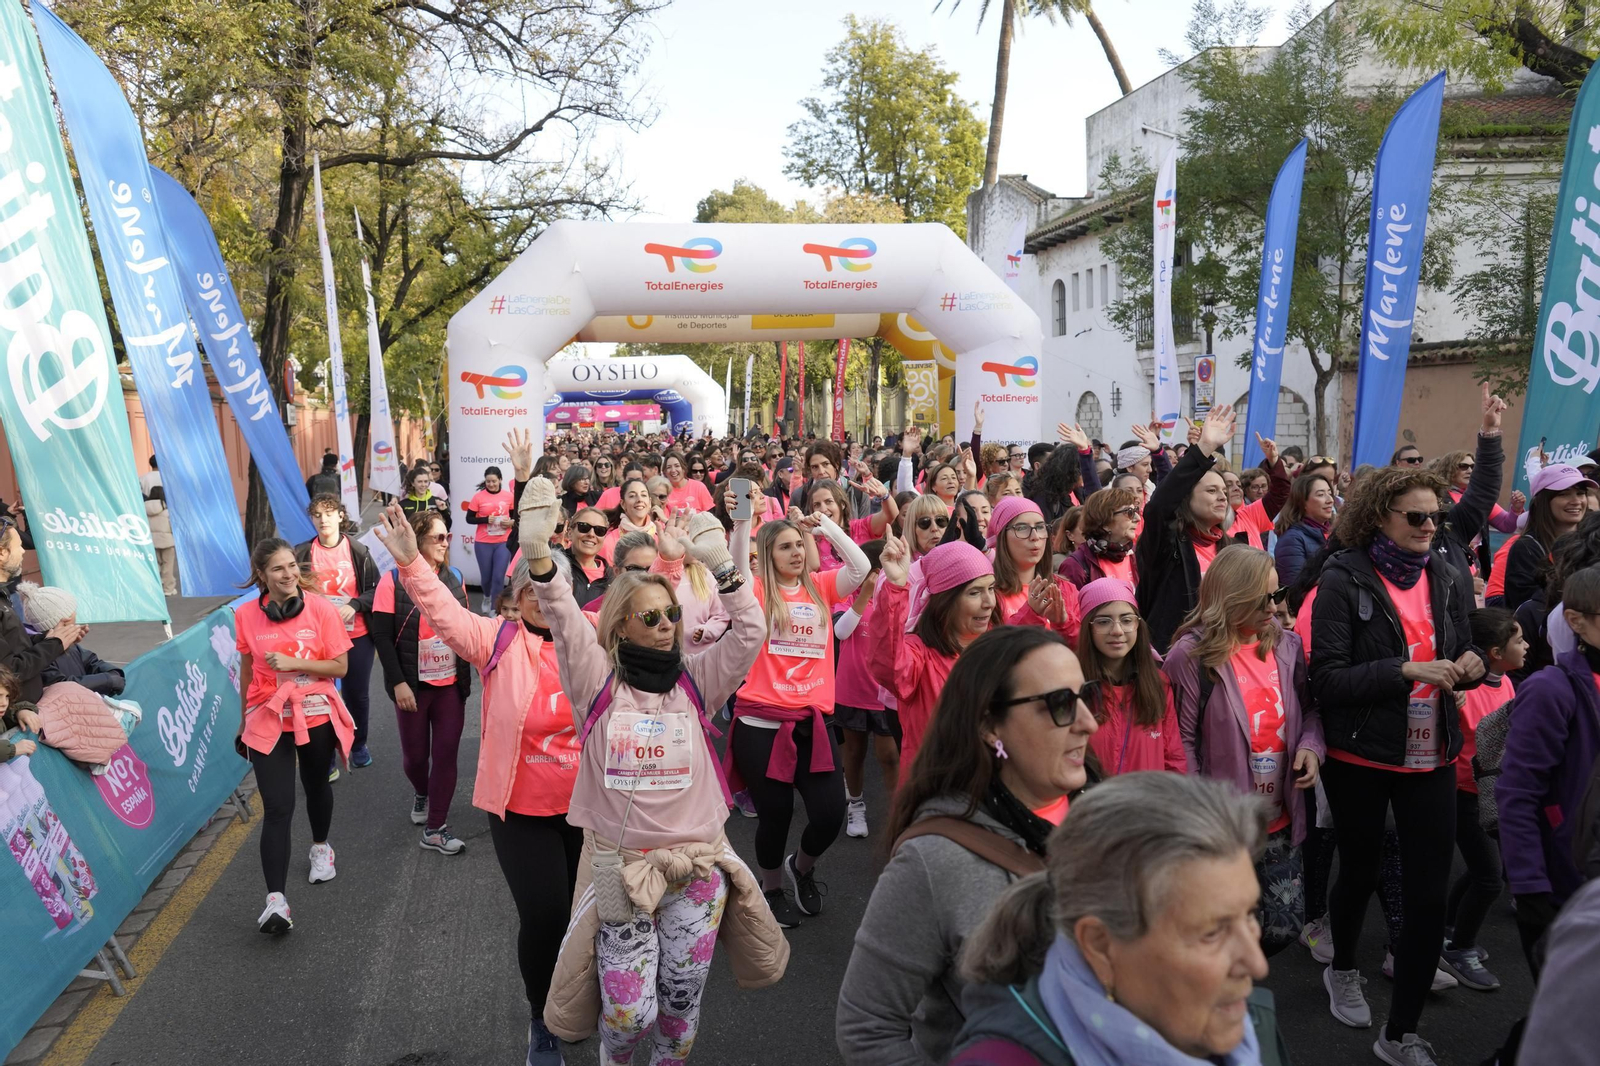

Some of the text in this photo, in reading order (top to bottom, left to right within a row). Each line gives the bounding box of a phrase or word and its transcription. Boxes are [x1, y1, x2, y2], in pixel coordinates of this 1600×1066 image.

[645, 281, 724, 292] TotalEnergies
[803, 280, 878, 291] TotalEnergies
[1369, 203, 1413, 361] Marlene
[1256, 247, 1283, 382] Marlene
[690, 322, 727, 330] Deportes
[572, 363, 658, 382] OYSHO
[981, 393, 1038, 404] TotalEnergies
[460, 406, 527, 417] TotalEnergies
[460, 455, 512, 464] totalenergie
[791, 625, 813, 635] 016
[434, 654, 449, 663] 016
[773, 681, 795, 691] CARRERA
[797, 681, 804, 691] DE
[157, 660, 207, 767] Batiste
[187, 695, 222, 793] CHAMPÚ EN SECO
[559, 754, 568, 763] DE
[568, 752, 577, 762] LA
[636, 745, 664, 759] 016
[120, 786, 148, 814] ESPAÑA
